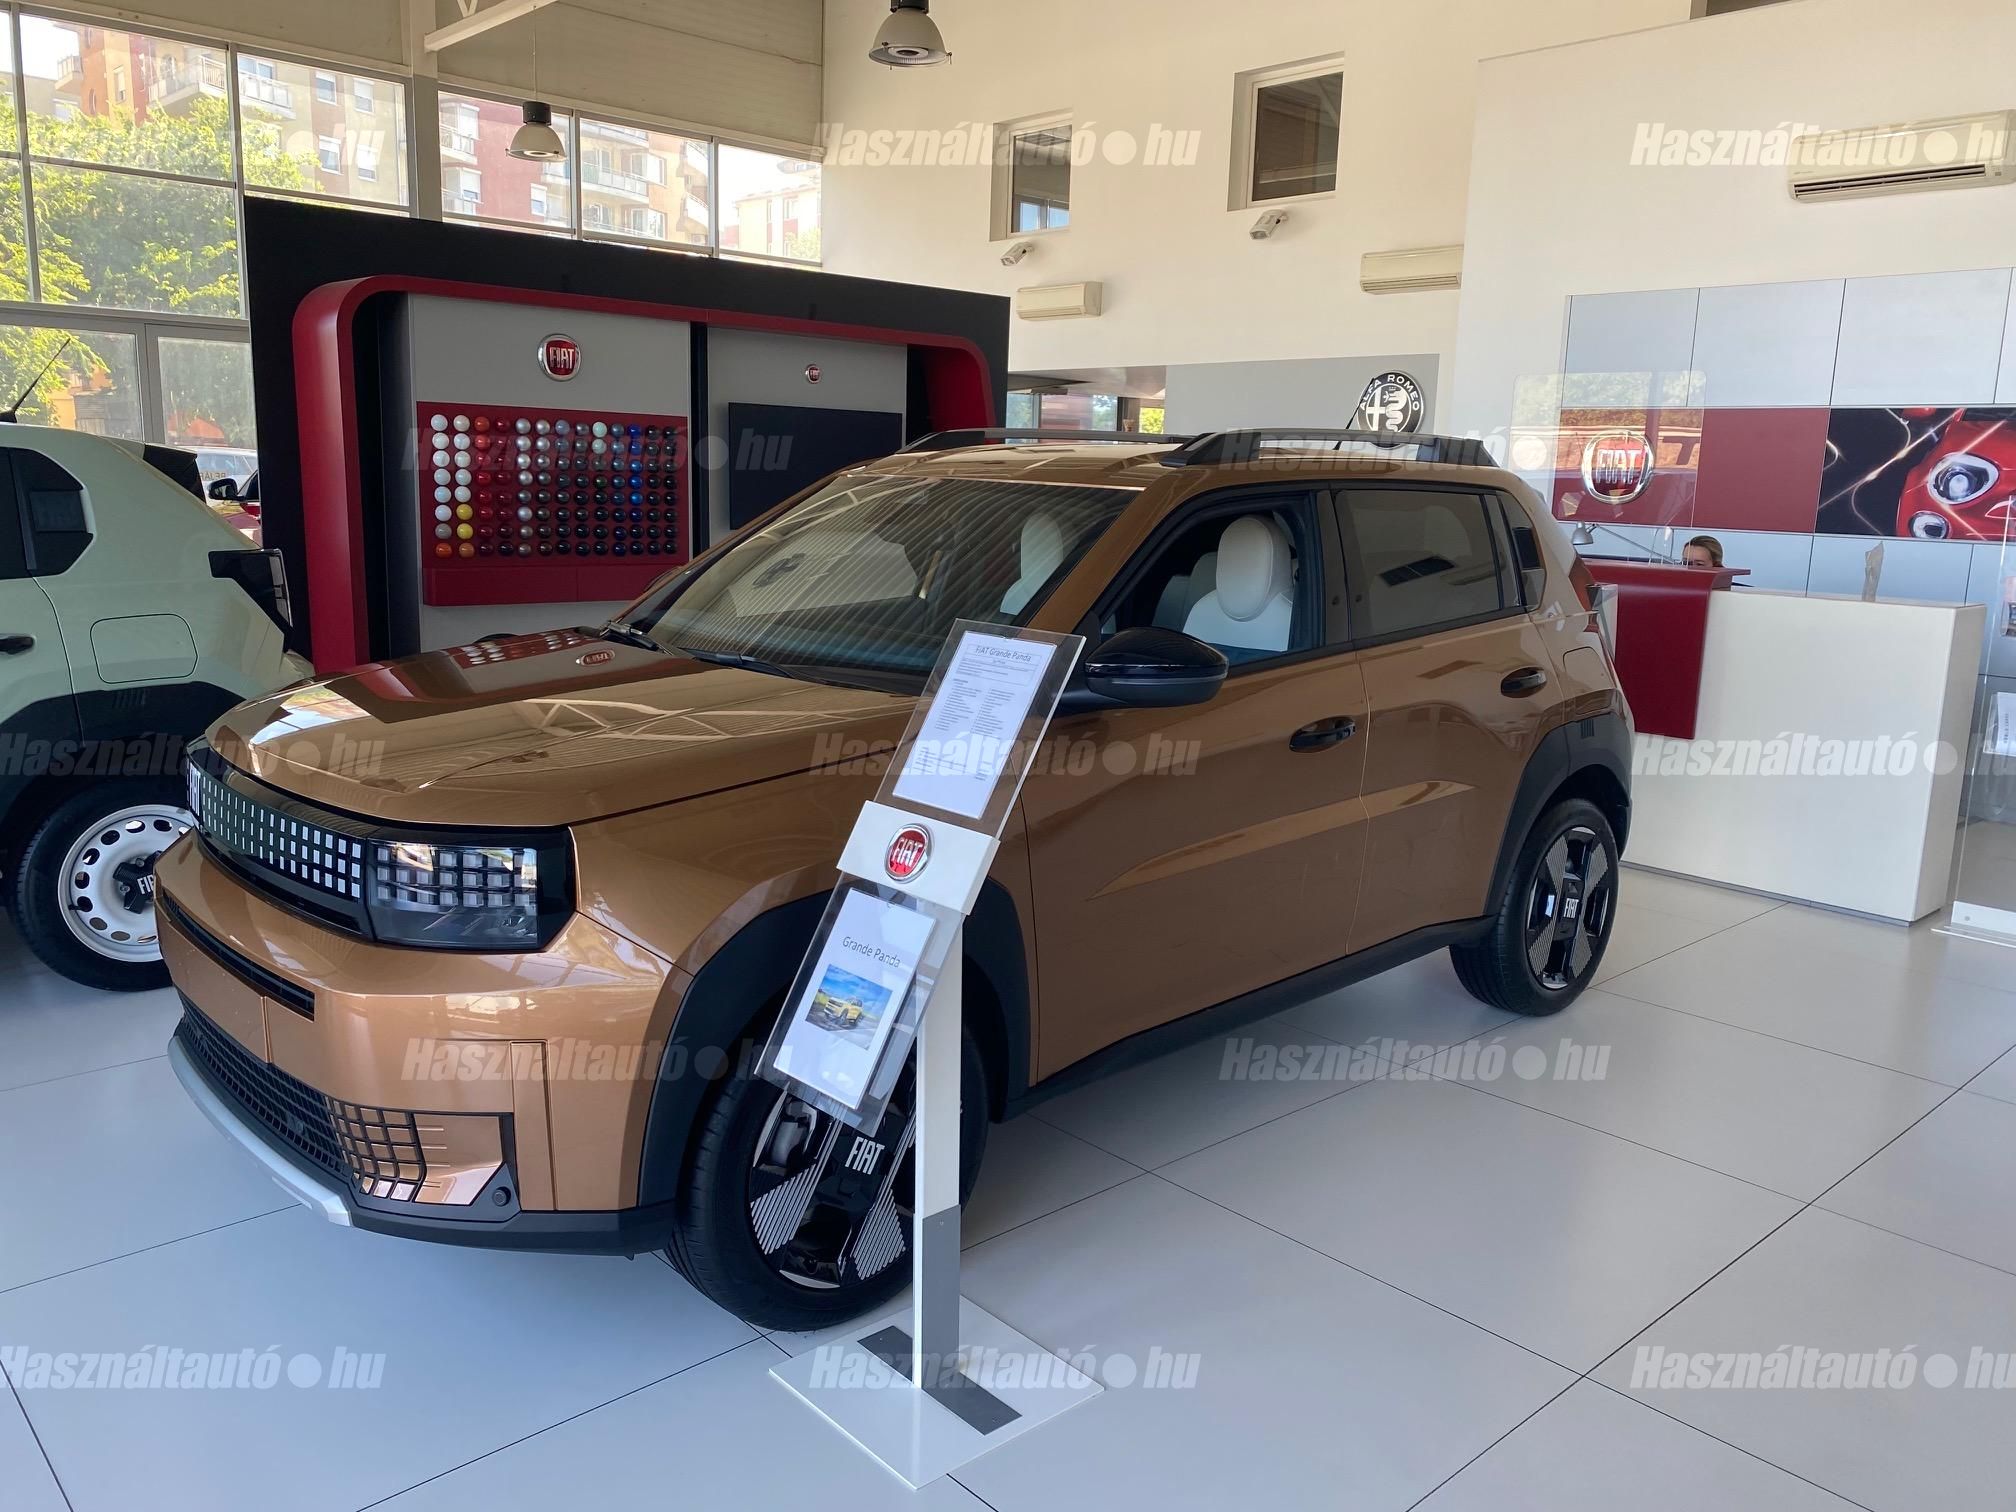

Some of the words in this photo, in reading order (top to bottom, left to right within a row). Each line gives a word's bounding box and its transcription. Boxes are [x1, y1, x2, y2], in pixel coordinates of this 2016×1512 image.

[549, 346, 575, 369] FIAT
[1359, 379, 1382, 411] ALFA
[1387, 374, 1420, 411] ROMEO
[1595, 448, 1643, 485] FIAT
[989, 648, 1012, 659] Grande
[1011, 651, 1032, 662] Panda
[891, 837, 923, 868] FIAT
[137, 874, 154, 894] FIA
[1563, 897, 1580, 919] FIAT
[842, 935, 873, 957] Grande
[873, 948, 901, 968] Panda
[844, 1136, 886, 1175] FIAT
